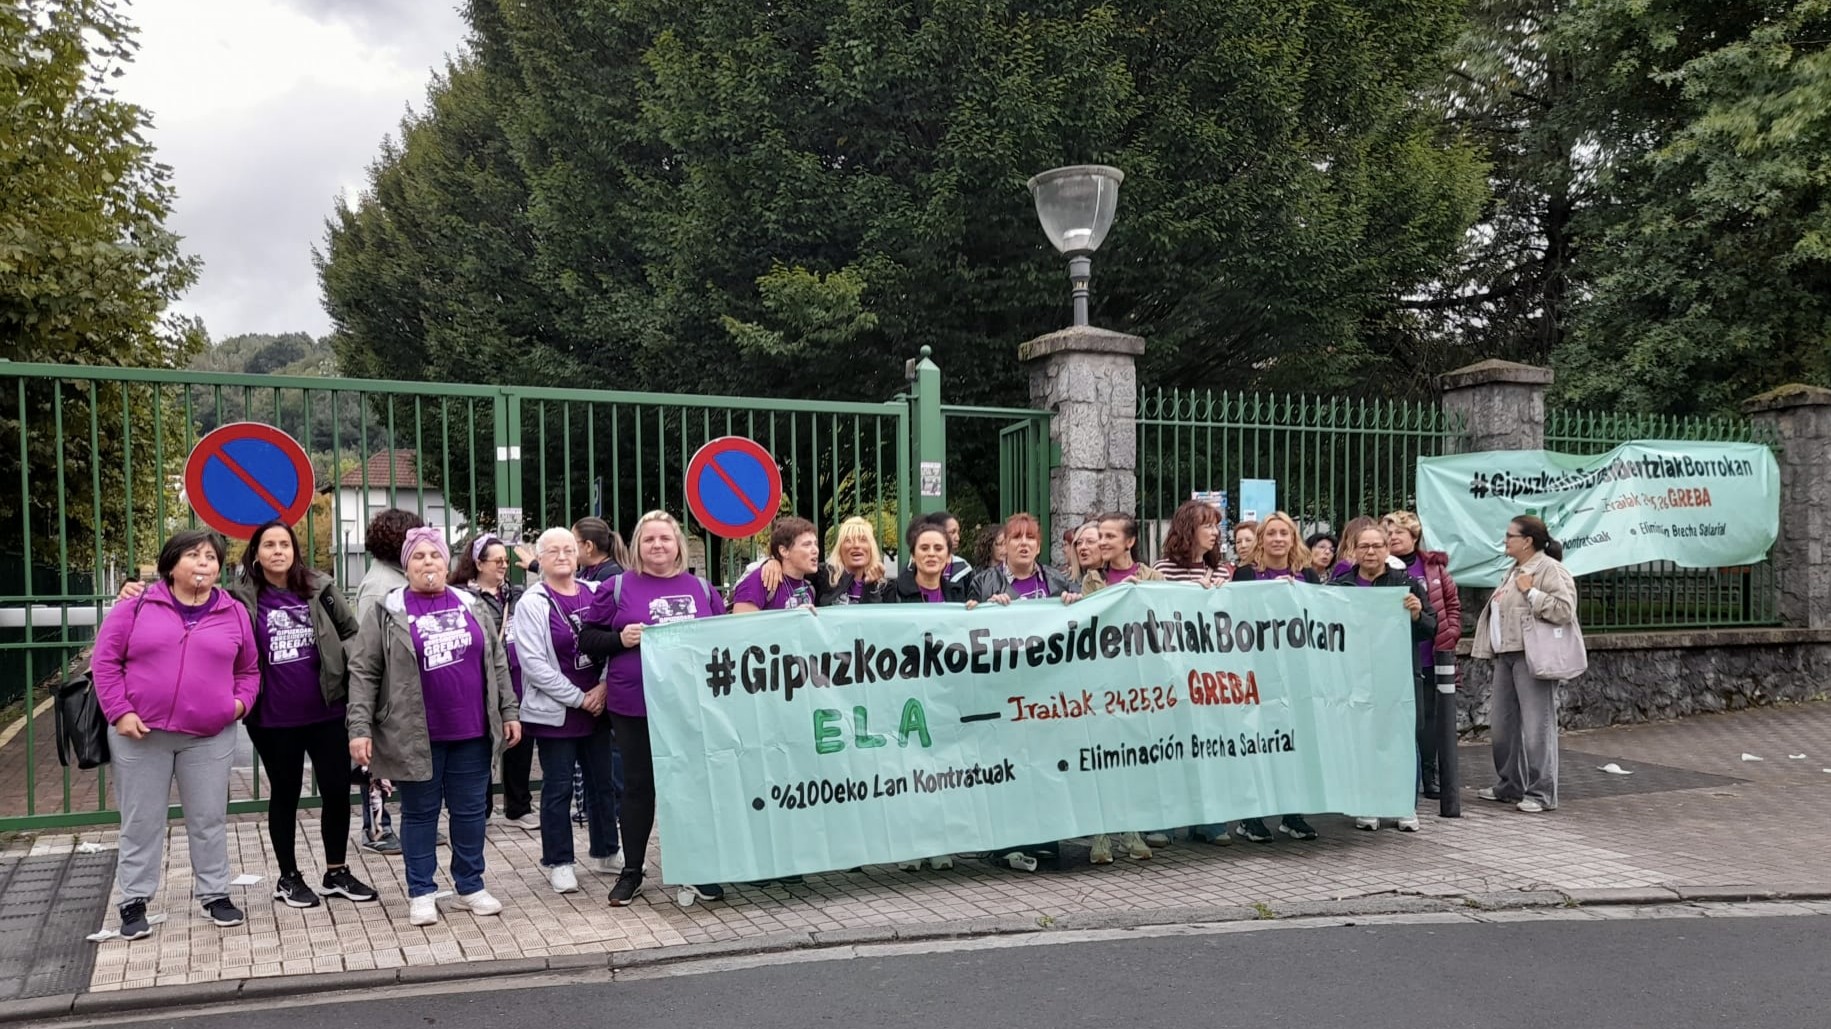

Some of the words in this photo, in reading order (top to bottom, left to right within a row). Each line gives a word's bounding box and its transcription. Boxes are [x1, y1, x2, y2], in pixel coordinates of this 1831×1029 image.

[1667, 486, 1712, 507] GREBA
[706, 608, 1345, 701] #GipuzkoakoErresidentziakBorrokan
[813, 698, 932, 754] ELA
[1007, 689, 1096, 722] Irailak
[1187, 669, 1260, 706] GREBA
[771, 778, 868, 810] %100eko
[873, 774, 908, 799] Lan
[913, 758, 1016, 793] Kontratuak
[1079, 734, 1184, 771] Eliminación
[1191, 734, 1237, 759] Brecha
[1239, 728, 1295, 757] Salarial
